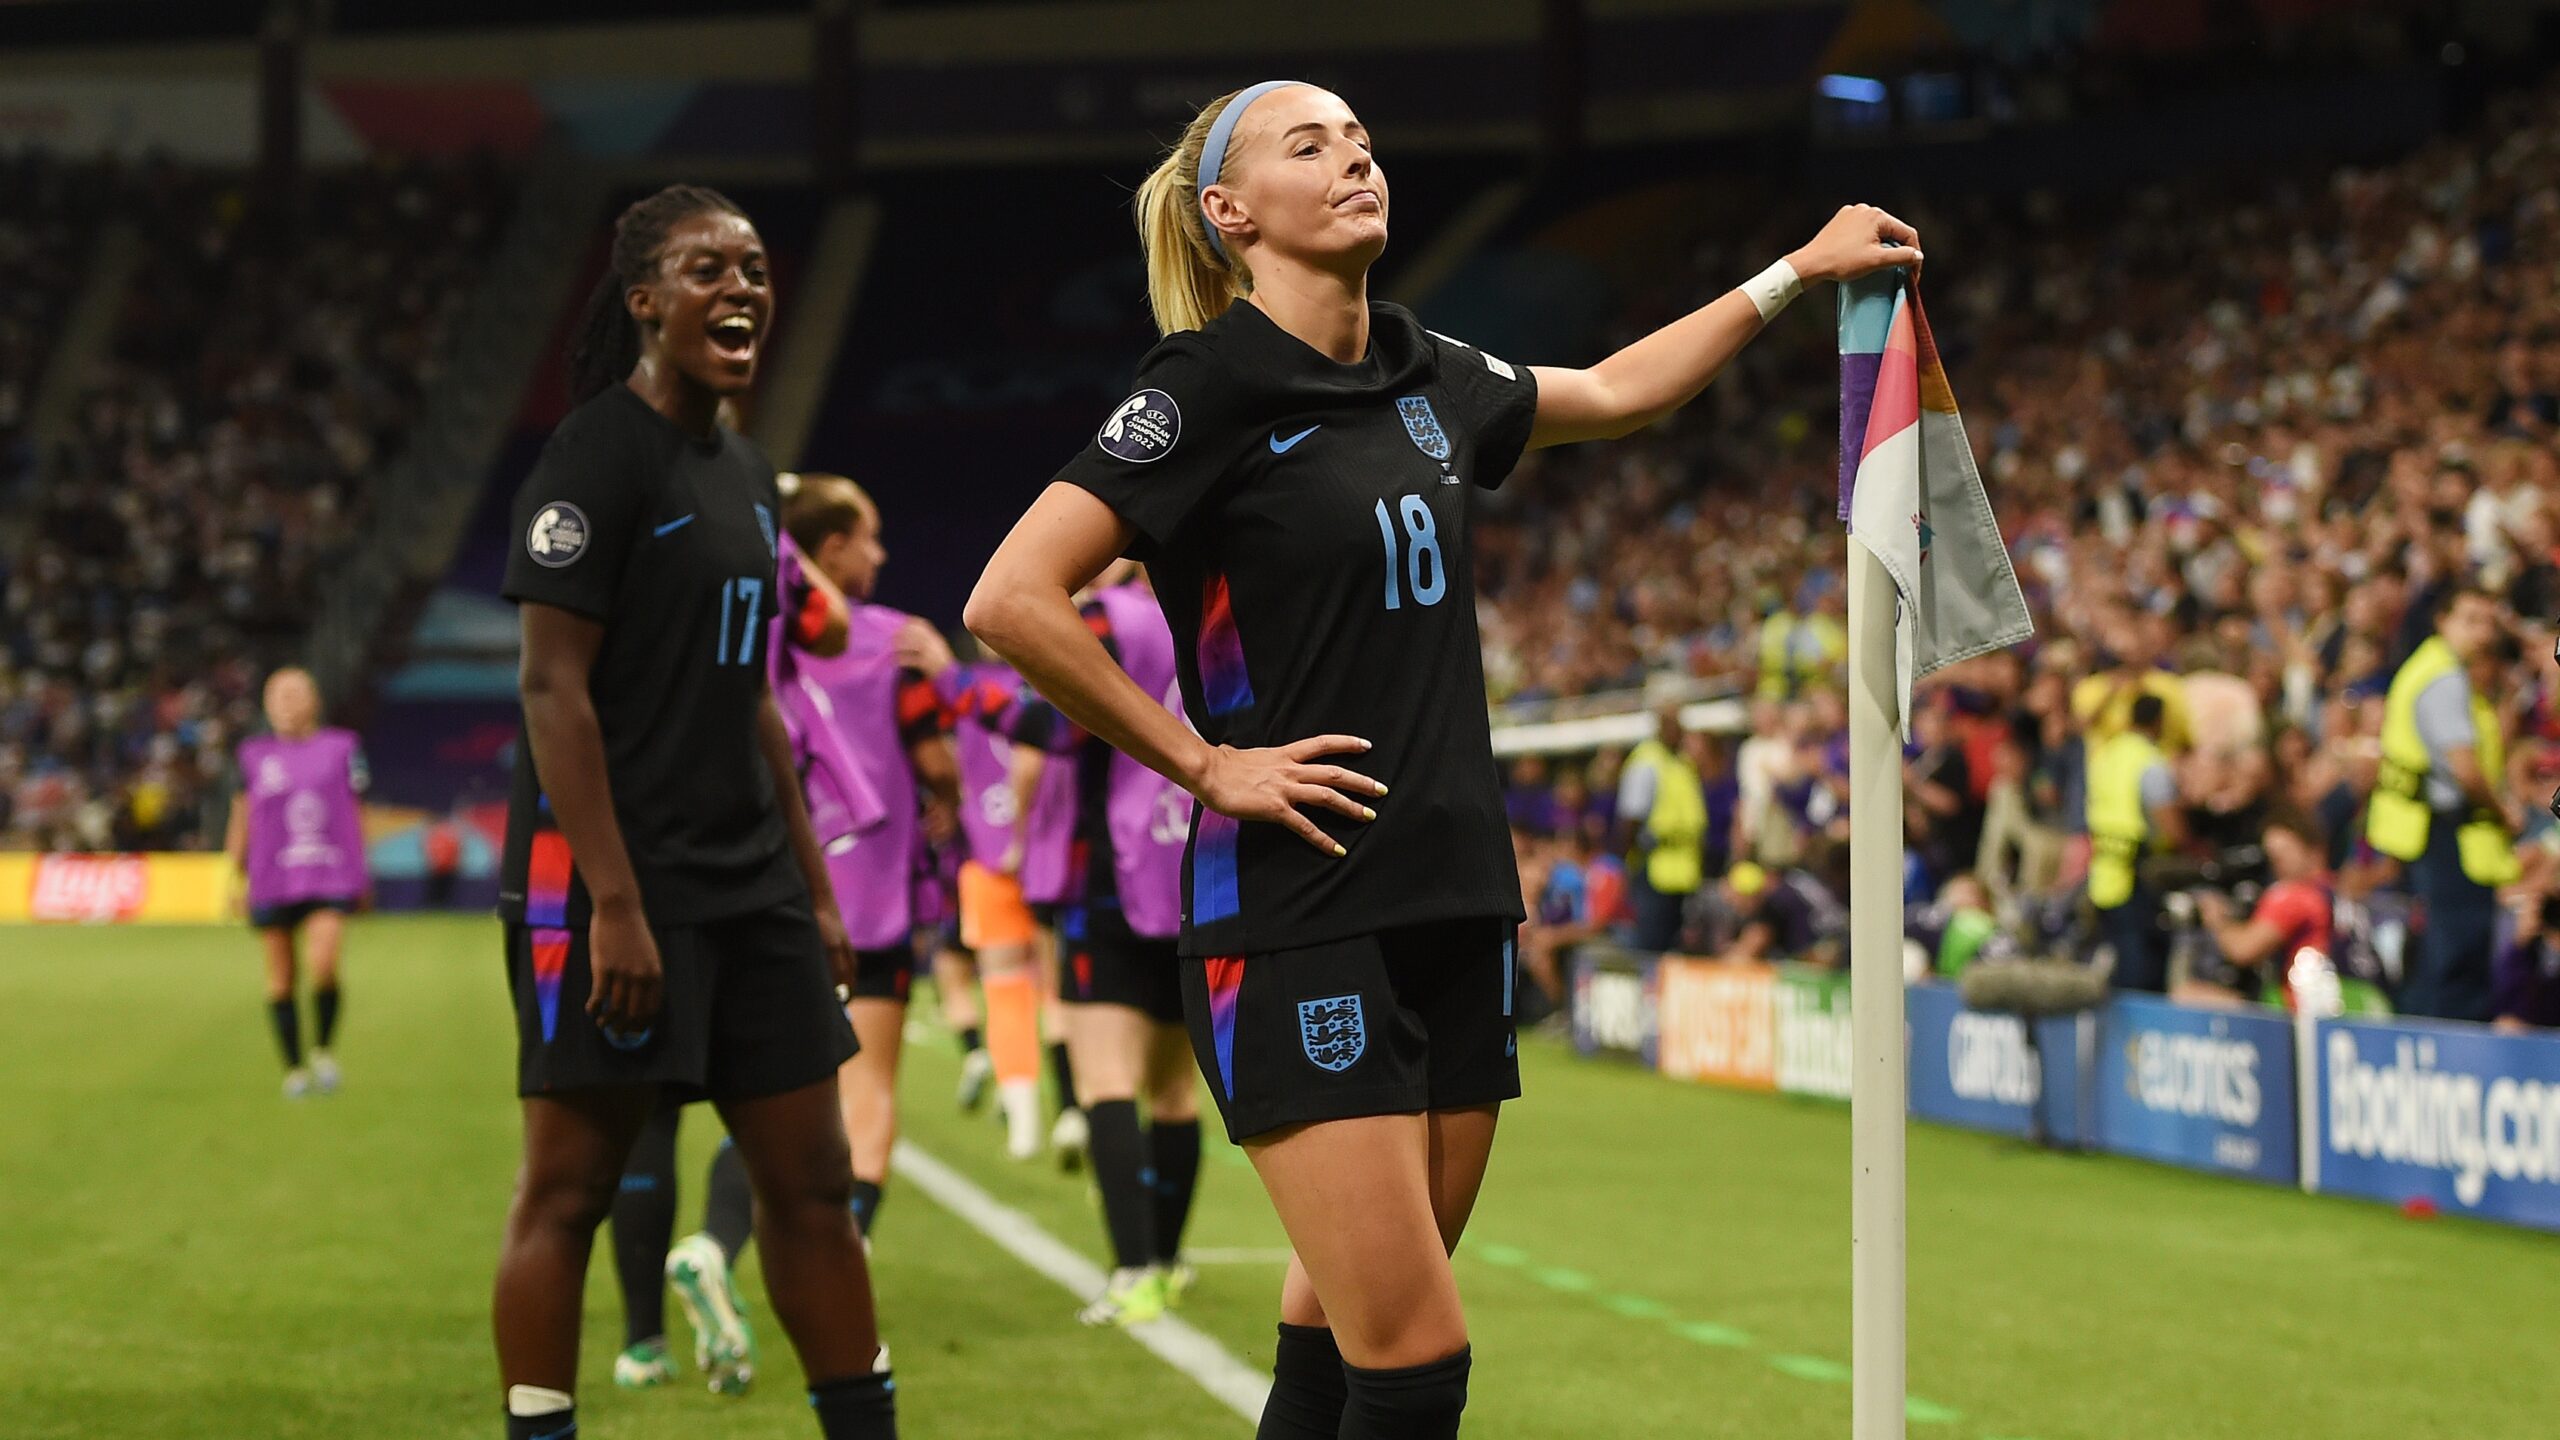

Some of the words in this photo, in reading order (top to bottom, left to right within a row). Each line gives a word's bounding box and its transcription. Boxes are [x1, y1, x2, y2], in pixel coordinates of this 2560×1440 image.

[1126, 421, 1168, 447] CHAMPIONS
[1128, 431, 1155, 450] 2022
[1132, 415, 1171, 440] EUROPEAN
[1374, 494, 1446, 610] 18
[716, 576, 764, 666] 17
